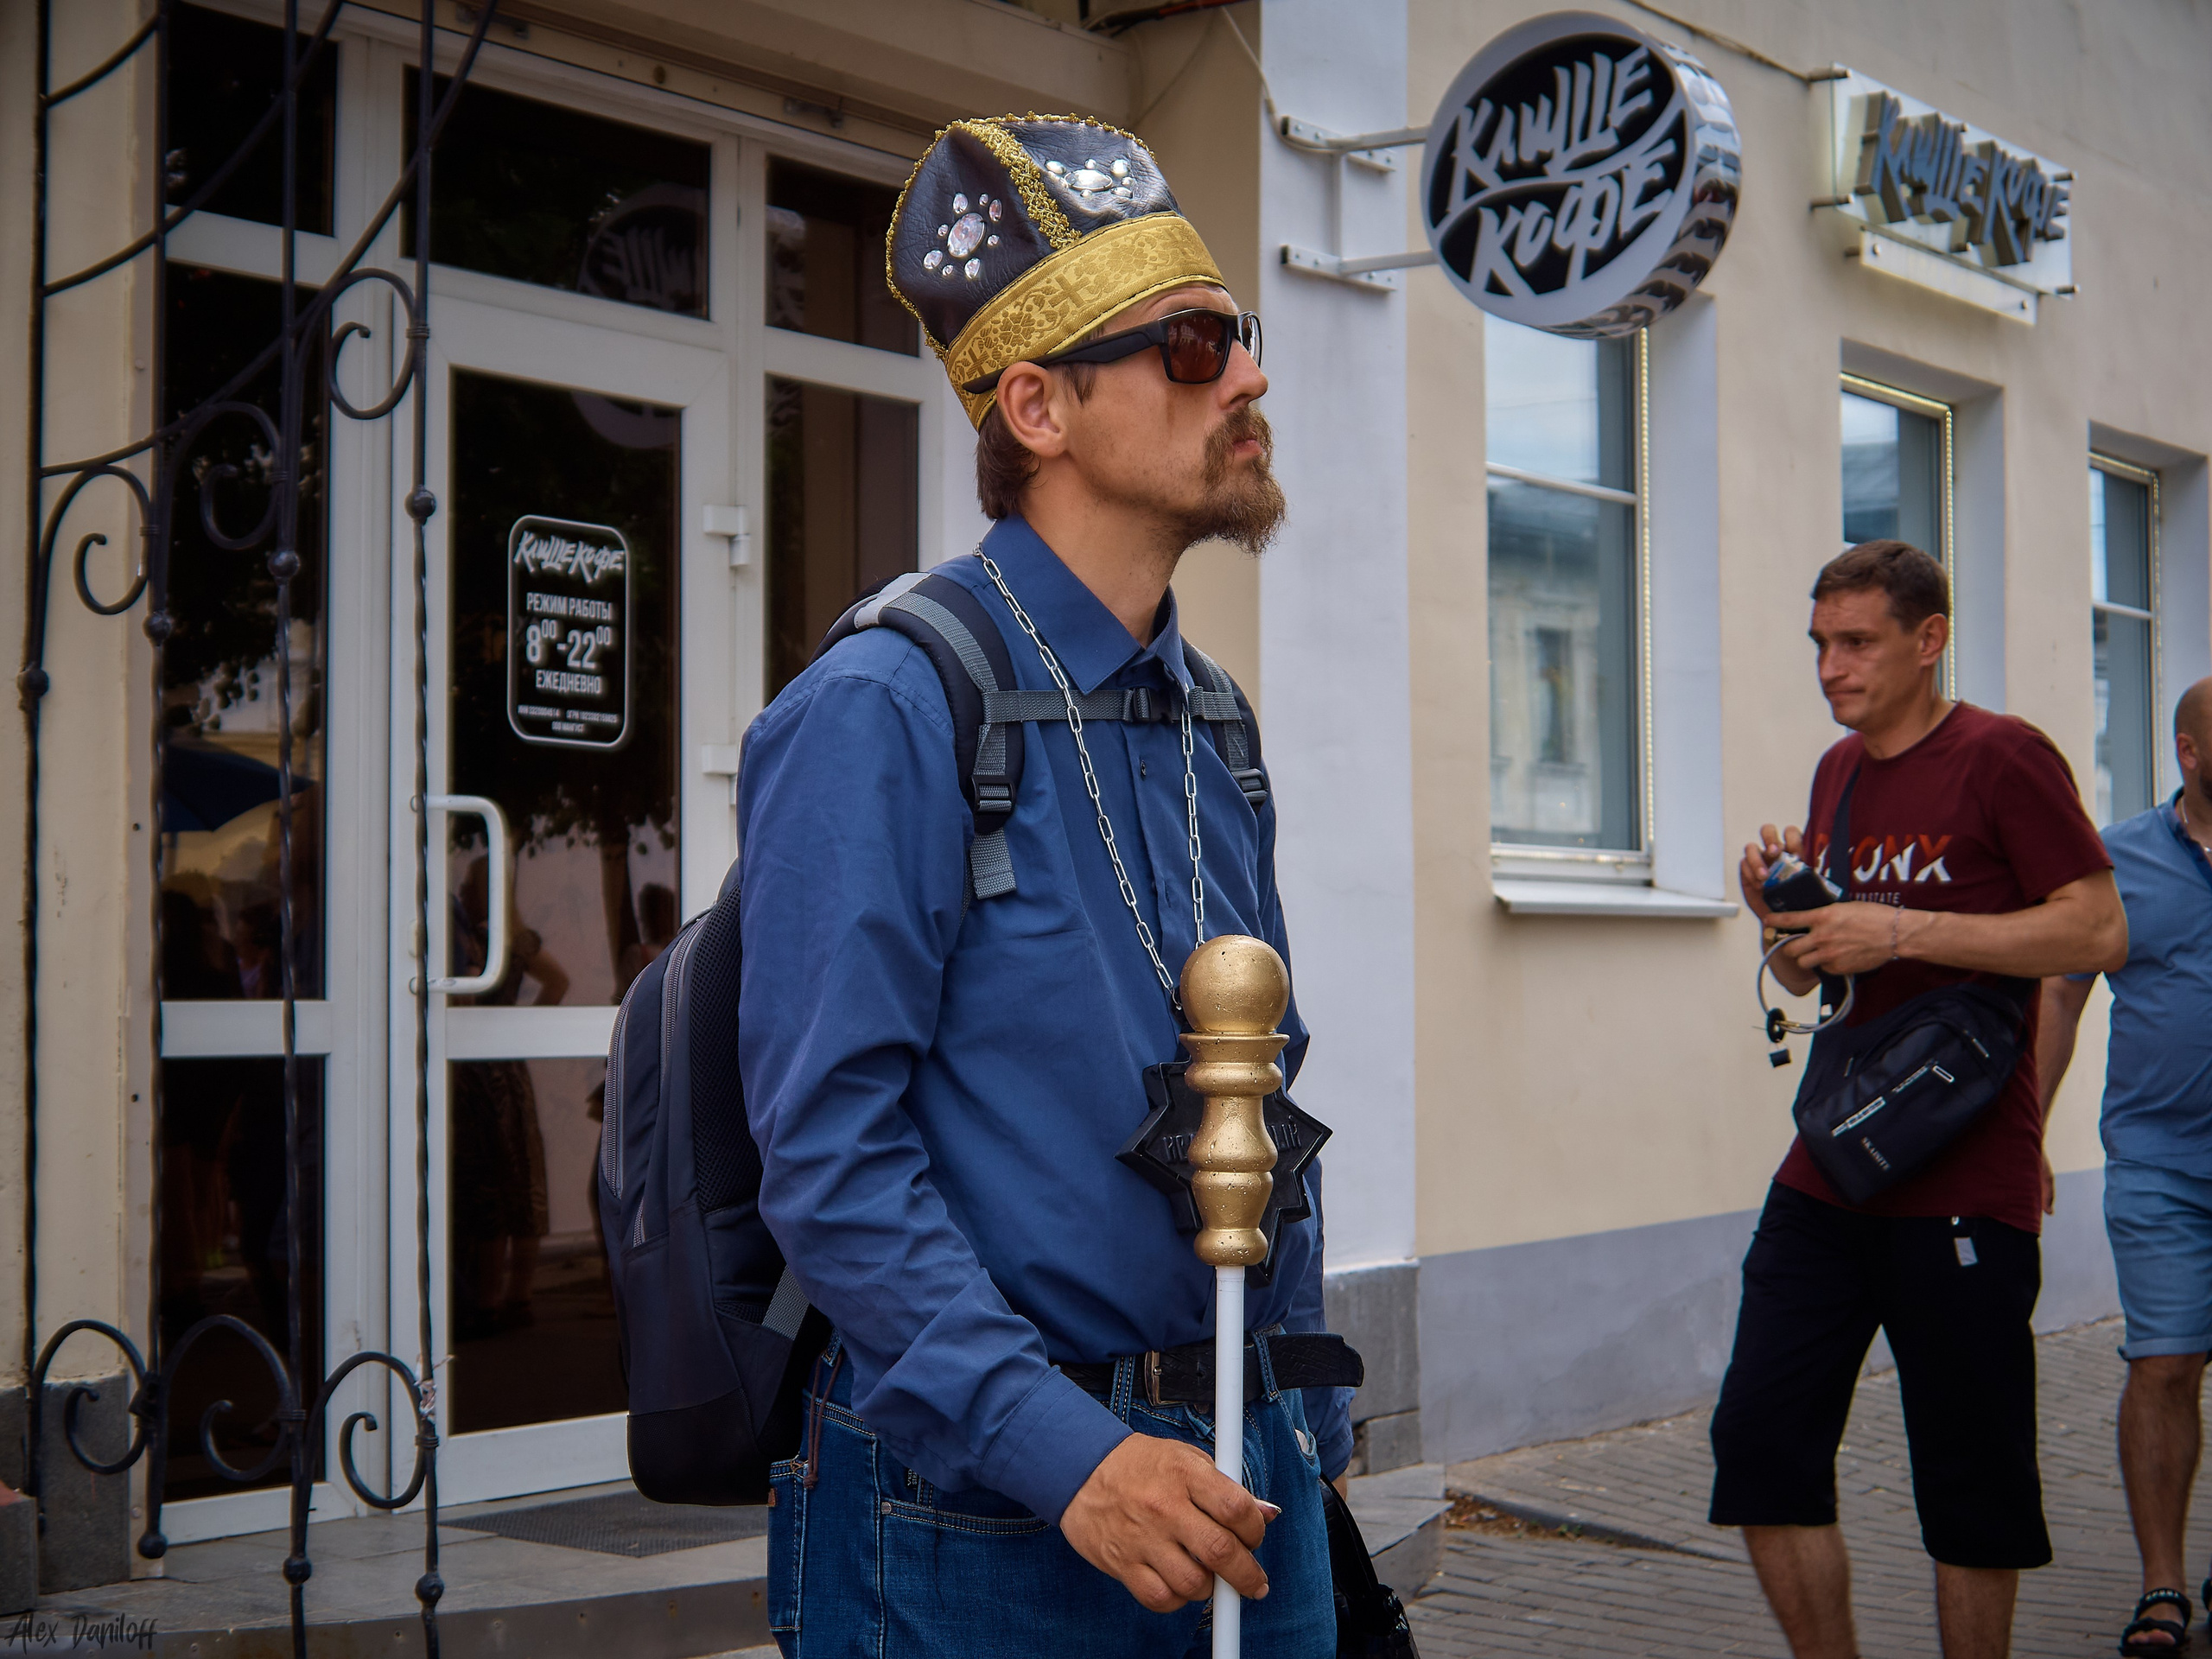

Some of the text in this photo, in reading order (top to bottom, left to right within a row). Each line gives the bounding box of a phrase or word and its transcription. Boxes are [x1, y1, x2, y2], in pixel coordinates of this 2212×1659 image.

[526, 592, 612, 620] РЕЖИМ РАБОТЫ
[536, 670, 603, 694] ЕЖЕДНЕВНО
[1815, 833, 1953, 882] BONX
